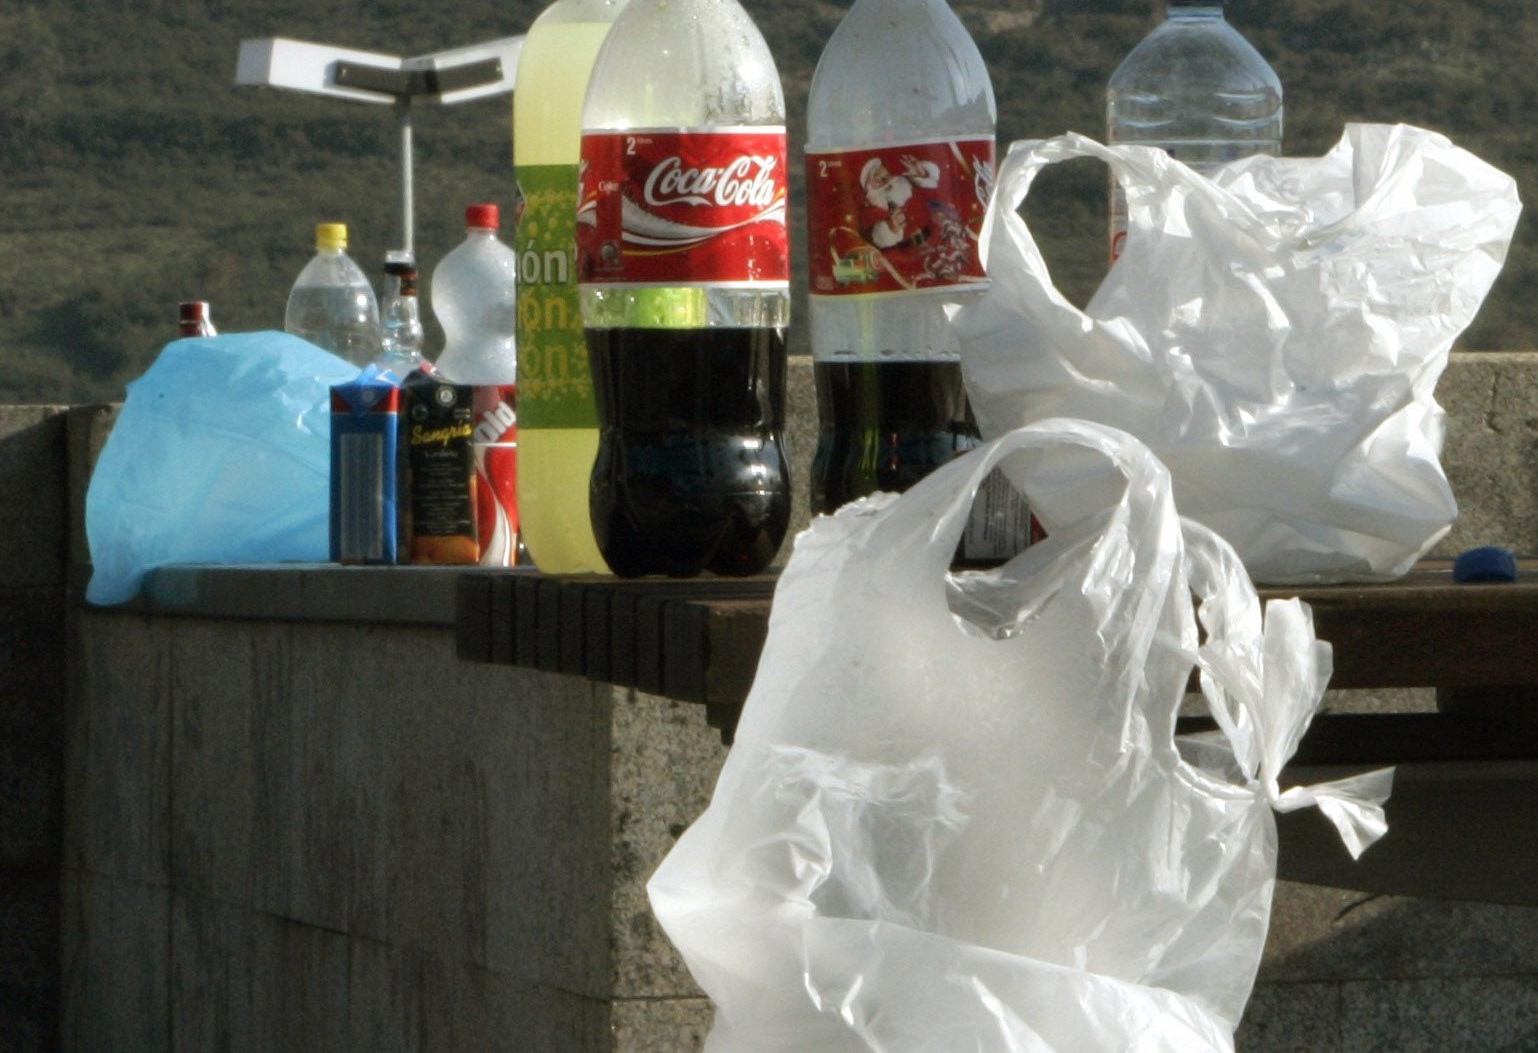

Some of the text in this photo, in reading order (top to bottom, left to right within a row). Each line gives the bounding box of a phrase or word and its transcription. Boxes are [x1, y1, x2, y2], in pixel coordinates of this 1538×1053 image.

[626, 136, 636, 156] 2
[818, 160, 828, 178] 2
[644, 155, 776, 207] Coca-Cola
